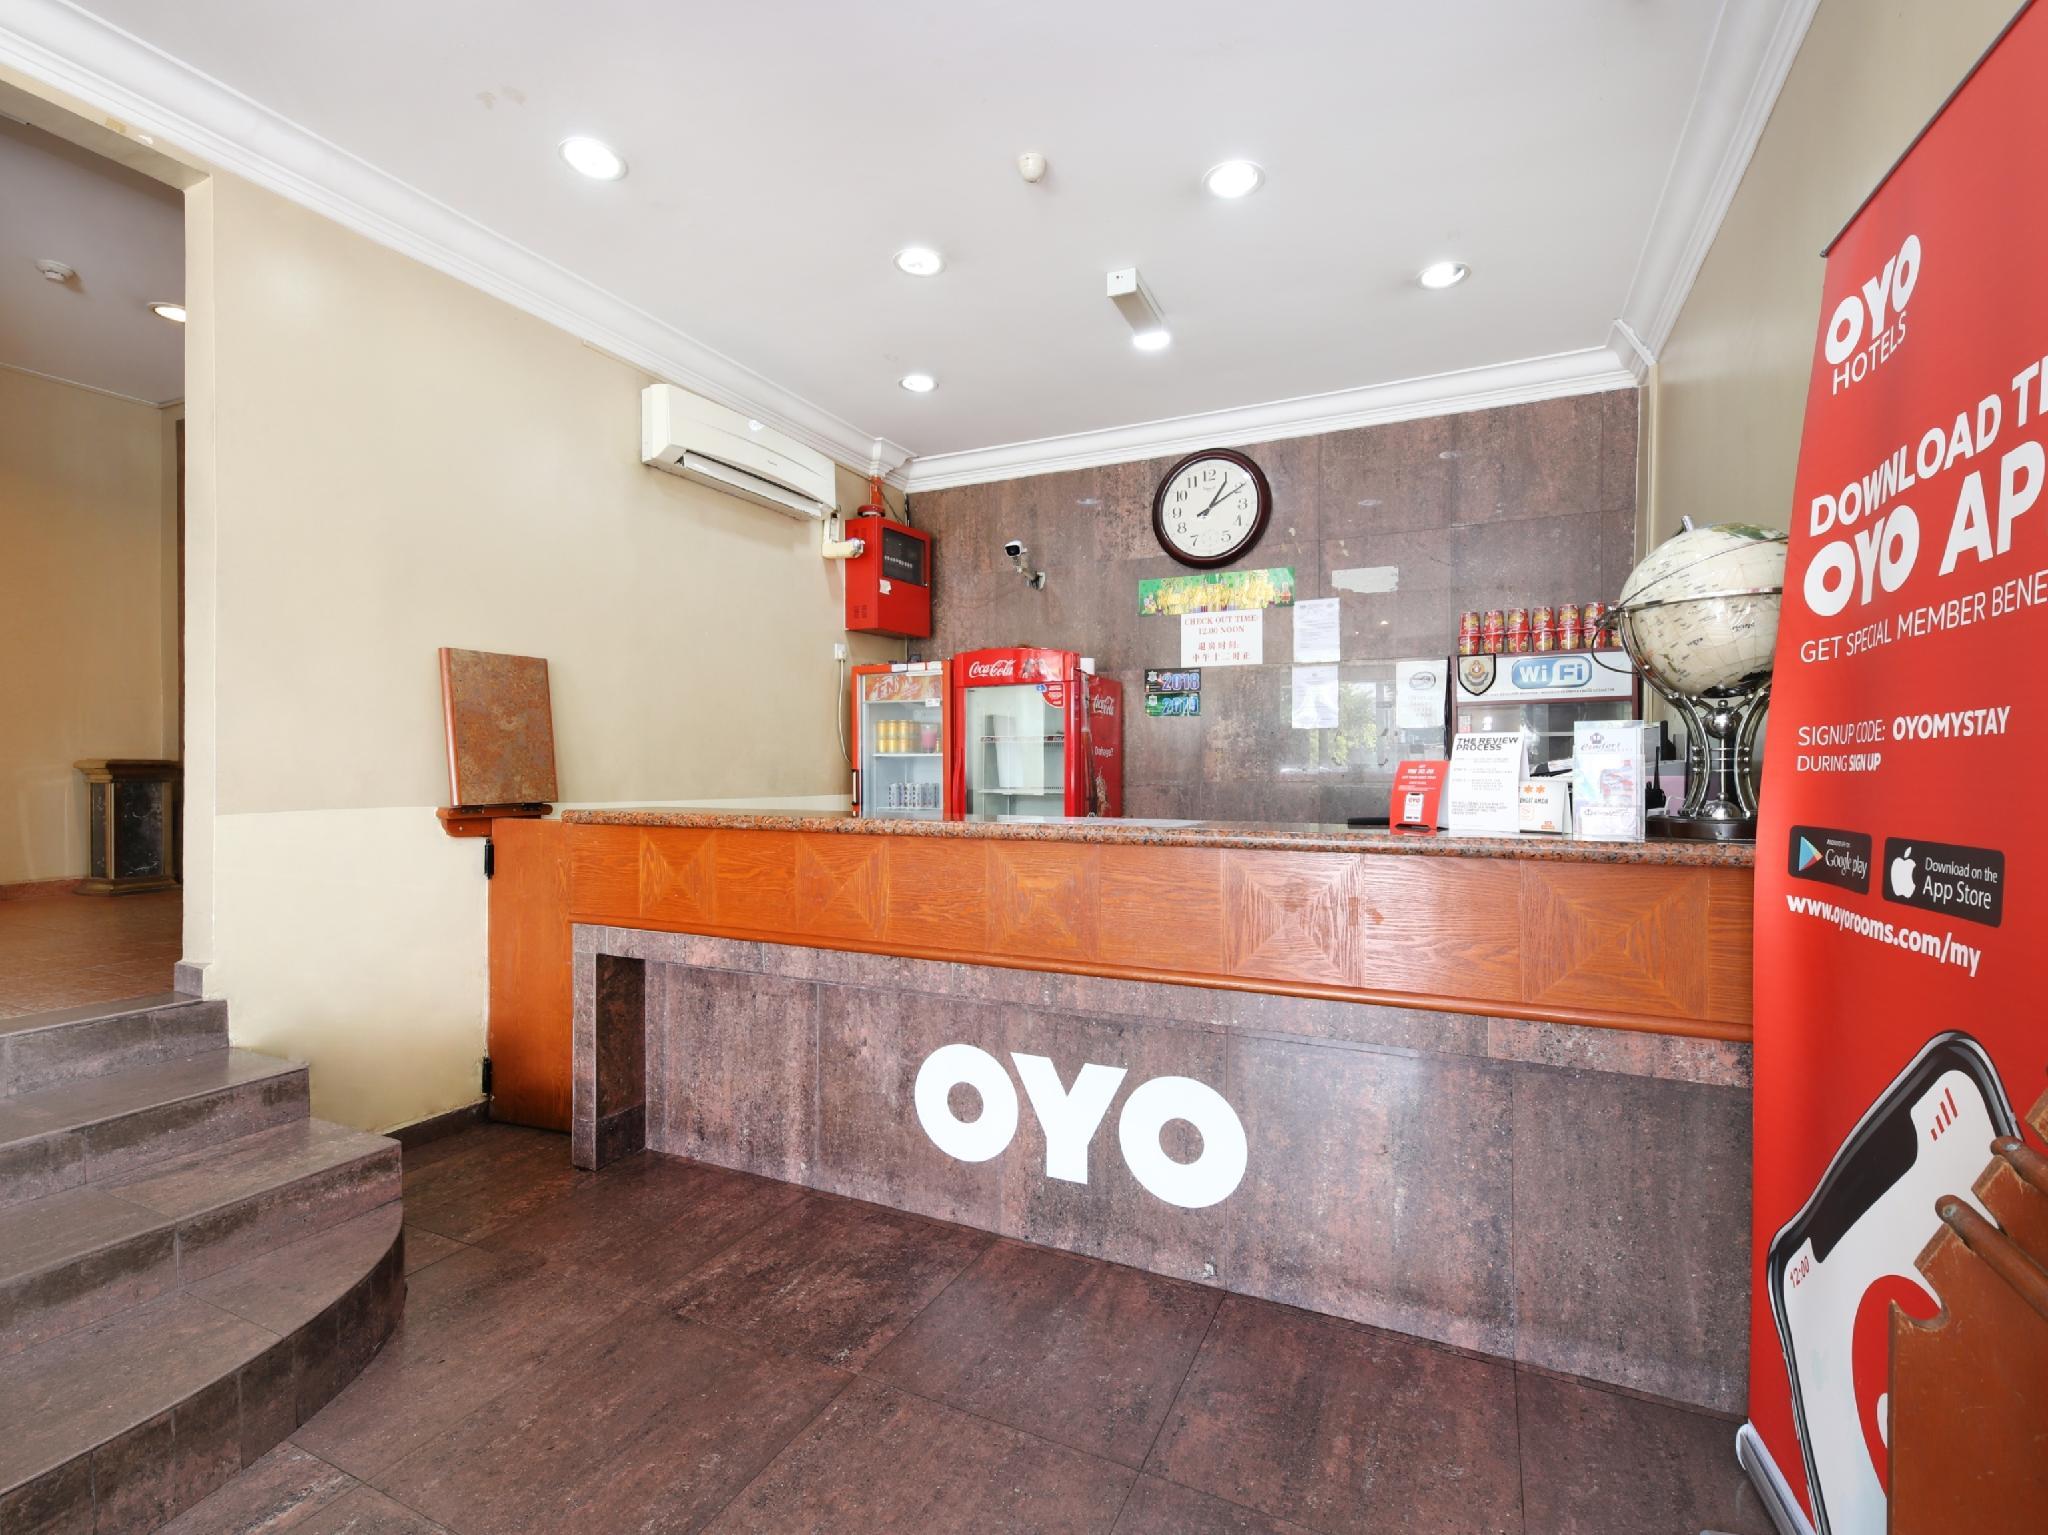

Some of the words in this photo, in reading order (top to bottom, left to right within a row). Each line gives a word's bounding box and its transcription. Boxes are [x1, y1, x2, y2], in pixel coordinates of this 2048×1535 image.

[1825, 234, 1921, 365] OYO
[1832, 310, 1907, 395] HOTELS
[1809, 394, 2002, 537] DOWNLOAD
[1187, 475, 1198, 489] 11
[1202, 469, 1217, 482] 12
[1175, 490, 1188, 502] 10
[1238, 497, 1248, 510] 3
[1172, 508, 1182, 519] 9
[1177, 522, 1187, 534] 8
[1221, 530, 1232, 543] 5
[1190, 534, 1199, 547] 7
[1803, 505, 1920, 616] OYO
[1184, 617, 1214, 626] CHECK
[1215, 615, 1233, 624] OUT
[1220, 625, 1245, 634] NOON
[1800, 635, 1843, 663] GET
[1846, 618, 1892, 657] SPECIAL
[1897, 591, 1986, 640] MEMBER
[1162, 672, 1200, 691] 2018
[1798, 723, 1855, 747] SIGNUP
[1856, 719, 1886, 744] CODE:
[1892, 705, 2011, 741] OYOMYSTAY
[1455, 743, 1502, 751] PROCESS
[1457, 737, 1477, 745] THE
[1479, 736, 1519, 745] REVIEW
[1797, 754, 1848, 772] DURING
[1867, 752, 1882, 771] UP
[1825, 848, 1851, 876] Google
[1852, 857, 1868, 880] play
[1925, 857, 1970, 878] Download
[1971, 869, 1982, 881] on
[1984, 867, 1998, 884] the
[1923, 875, 1953, 905] App
[1956, 880, 1992, 909] Store
[1785, 894, 1982, 978] www.oyorooms.com/my
[914, 1043, 1248, 1209] OYO
[1789, 1255, 1810, 1289] 12:00
